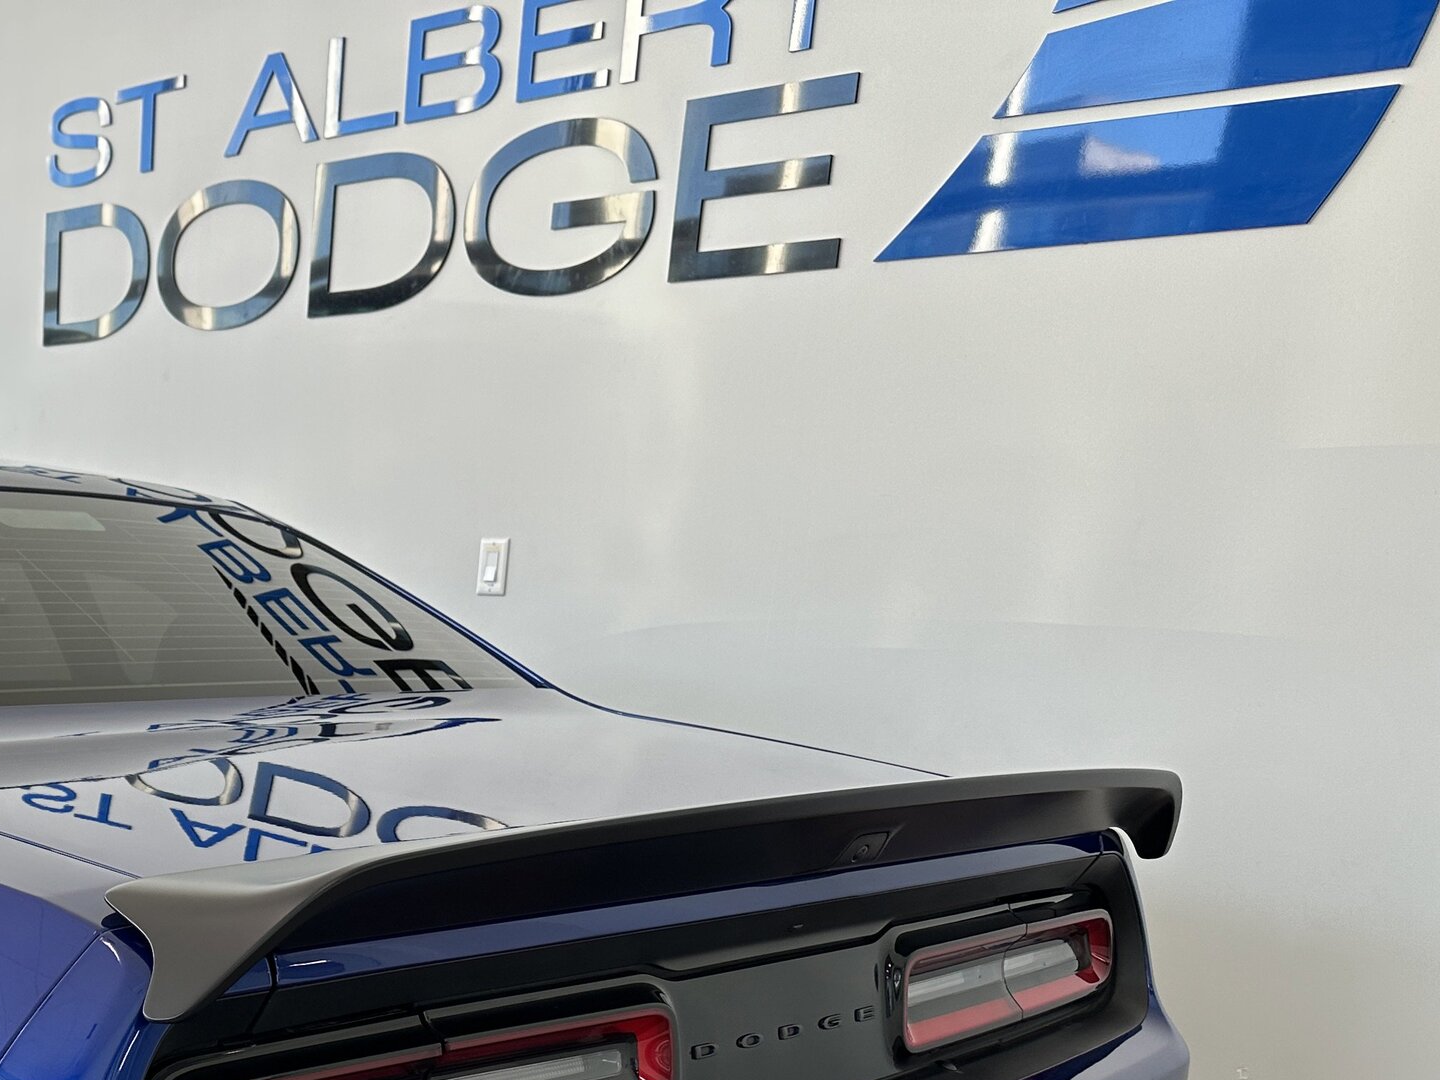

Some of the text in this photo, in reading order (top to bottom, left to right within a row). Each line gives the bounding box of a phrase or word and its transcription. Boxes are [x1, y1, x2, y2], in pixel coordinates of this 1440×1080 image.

[46, 74, 187, 188] ST
[43, 72, 862, 346] DODGE
[690, 1005, 876, 1061] DODGE
